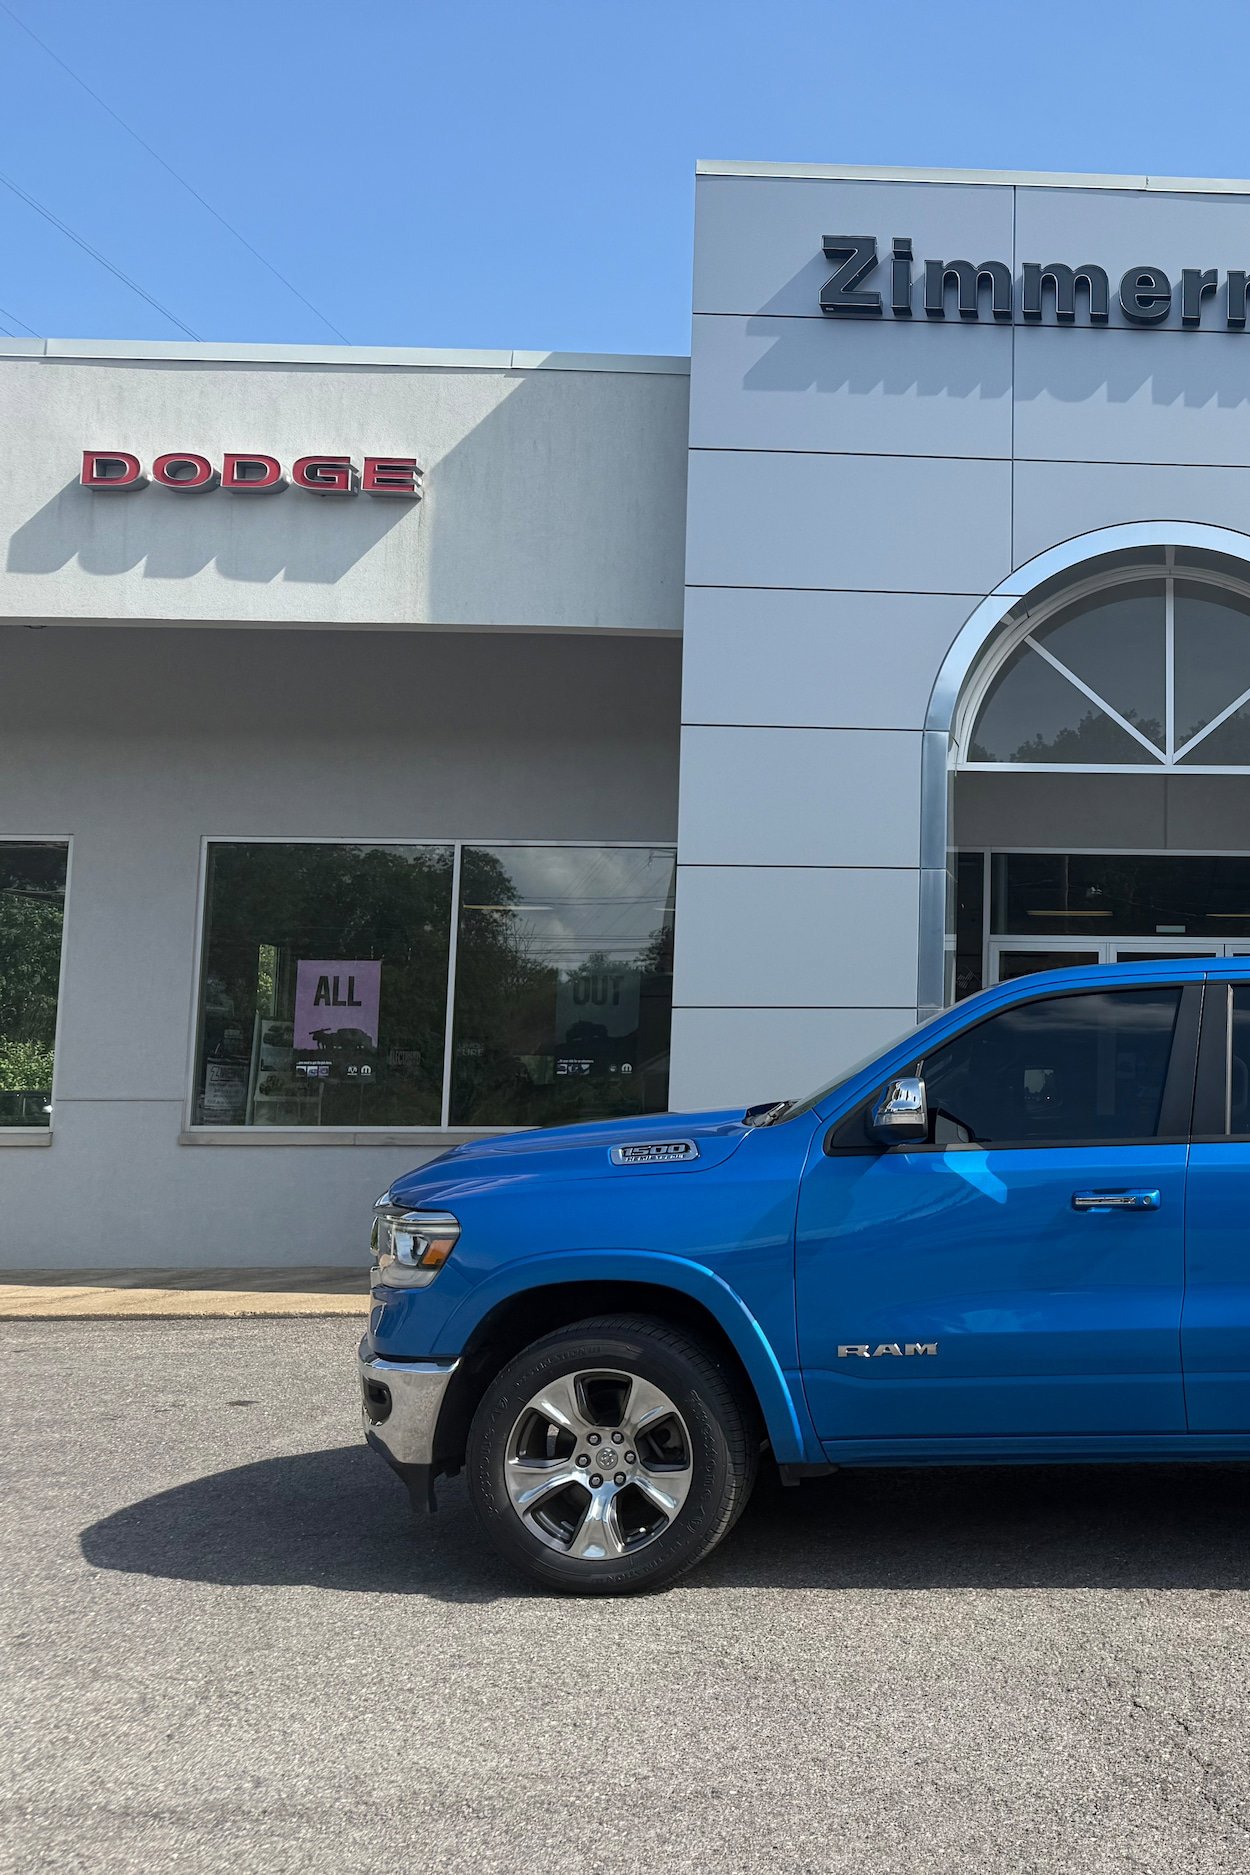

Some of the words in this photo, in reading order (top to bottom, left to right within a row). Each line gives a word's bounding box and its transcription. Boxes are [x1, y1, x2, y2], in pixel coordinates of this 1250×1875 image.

[79, 450, 422, 498] DODGE
[313, 975, 362, 1007] ALL
[572, 975, 625, 1006] OUT
[622, 1144, 686, 1157] 1500
[837, 1342, 938, 1358] RAM
